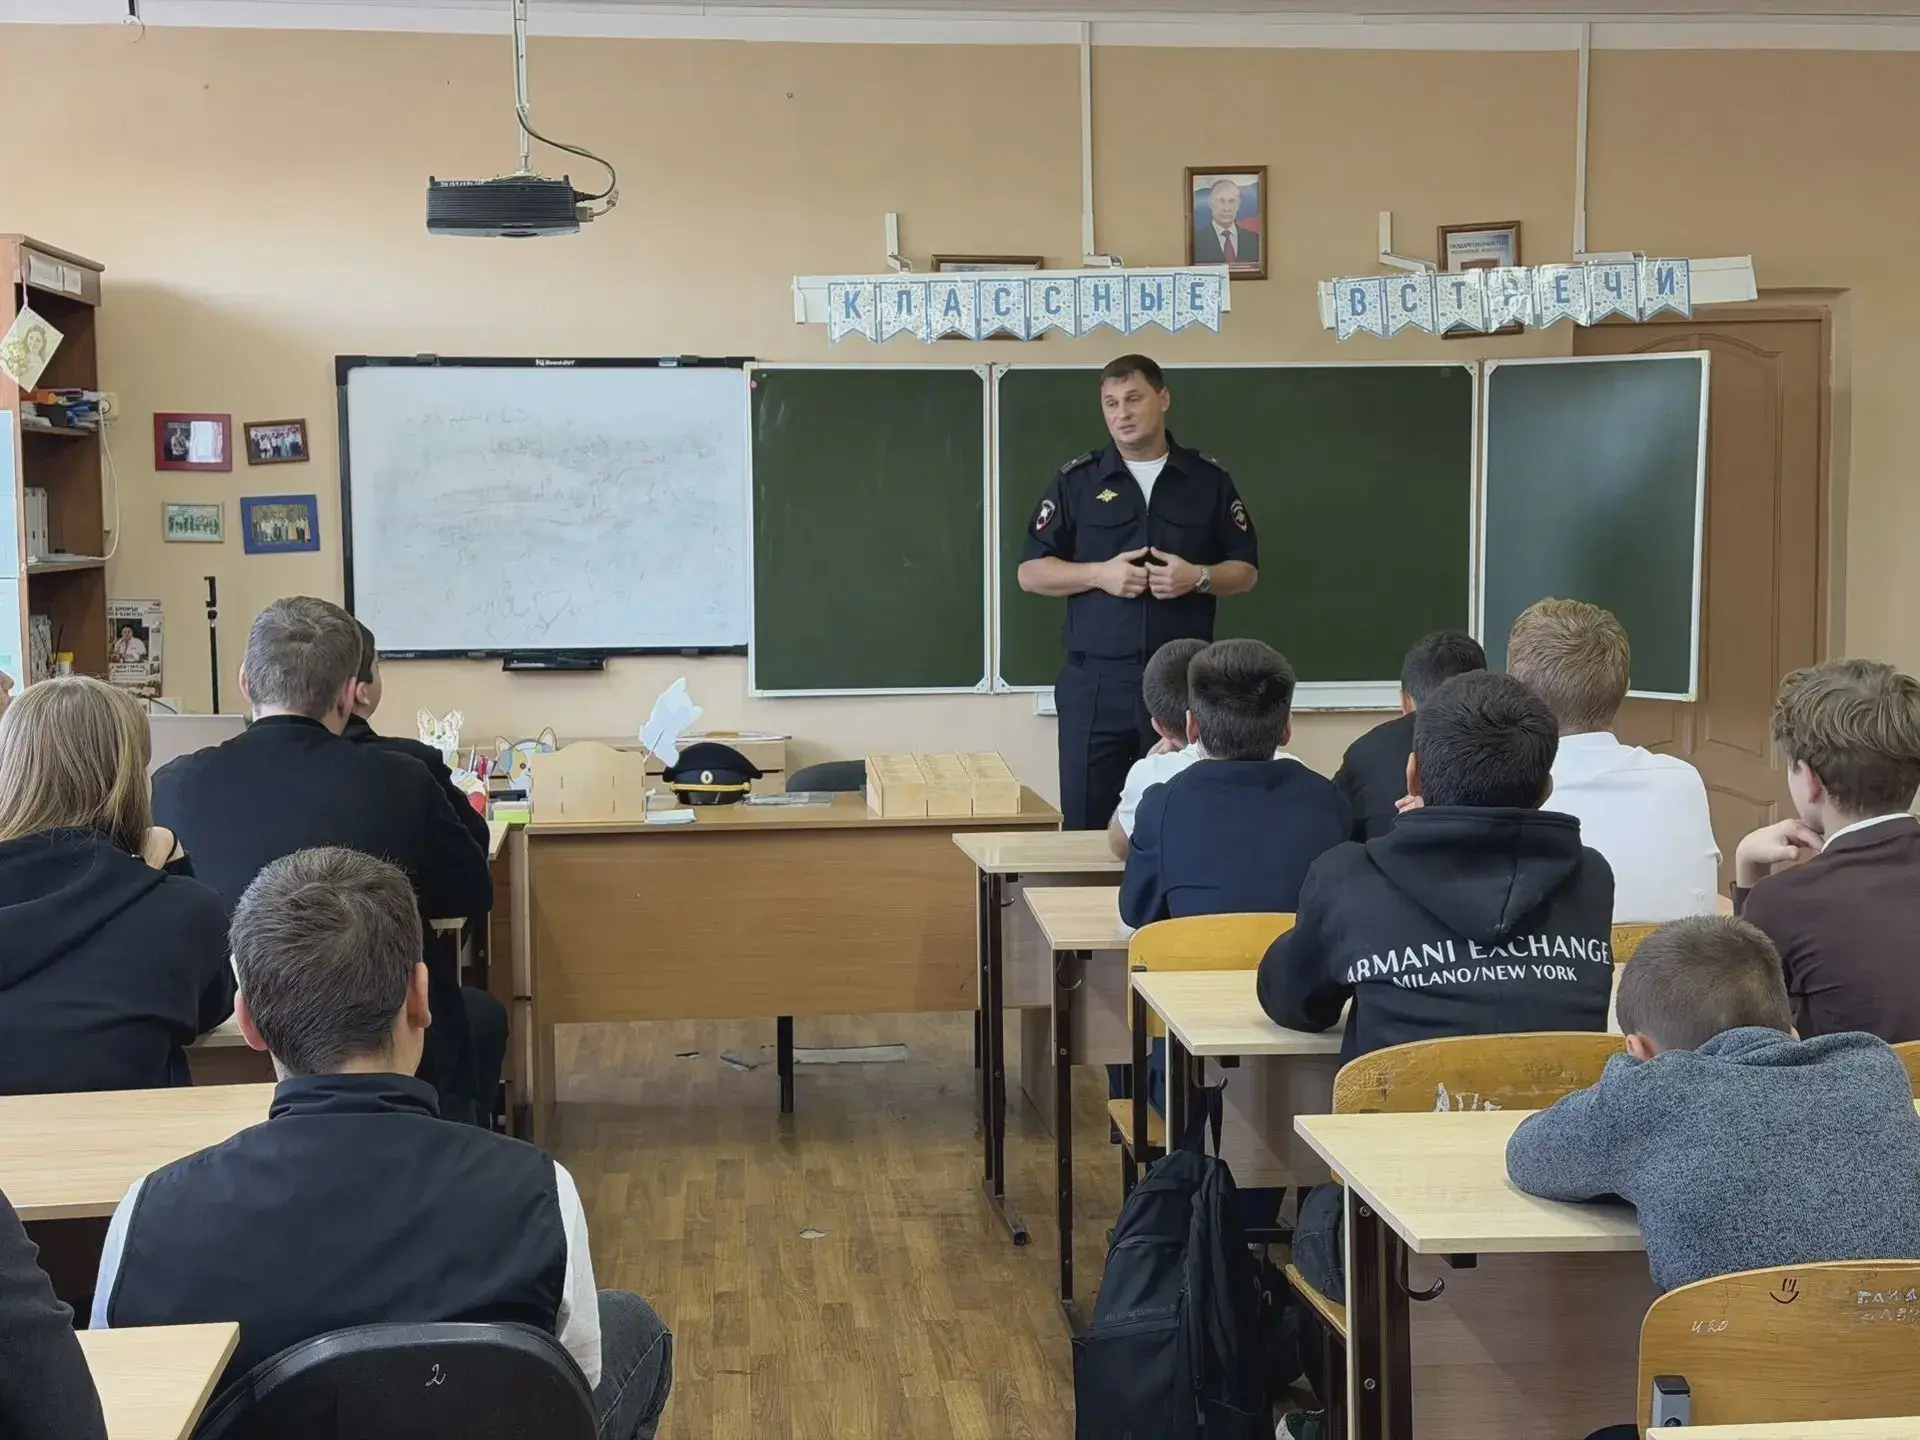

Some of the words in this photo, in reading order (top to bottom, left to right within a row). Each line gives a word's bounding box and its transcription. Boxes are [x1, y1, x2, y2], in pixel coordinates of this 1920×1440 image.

[844, 281, 1205, 320] КЛАССНЫЕ
[1349, 267, 1676, 317] ВСТРЕЧИ
[1347, 940, 1456, 983] ARMANI
[1393, 964, 1526, 988] MILANO/NEW
[1531, 965, 1578, 981] YORK
